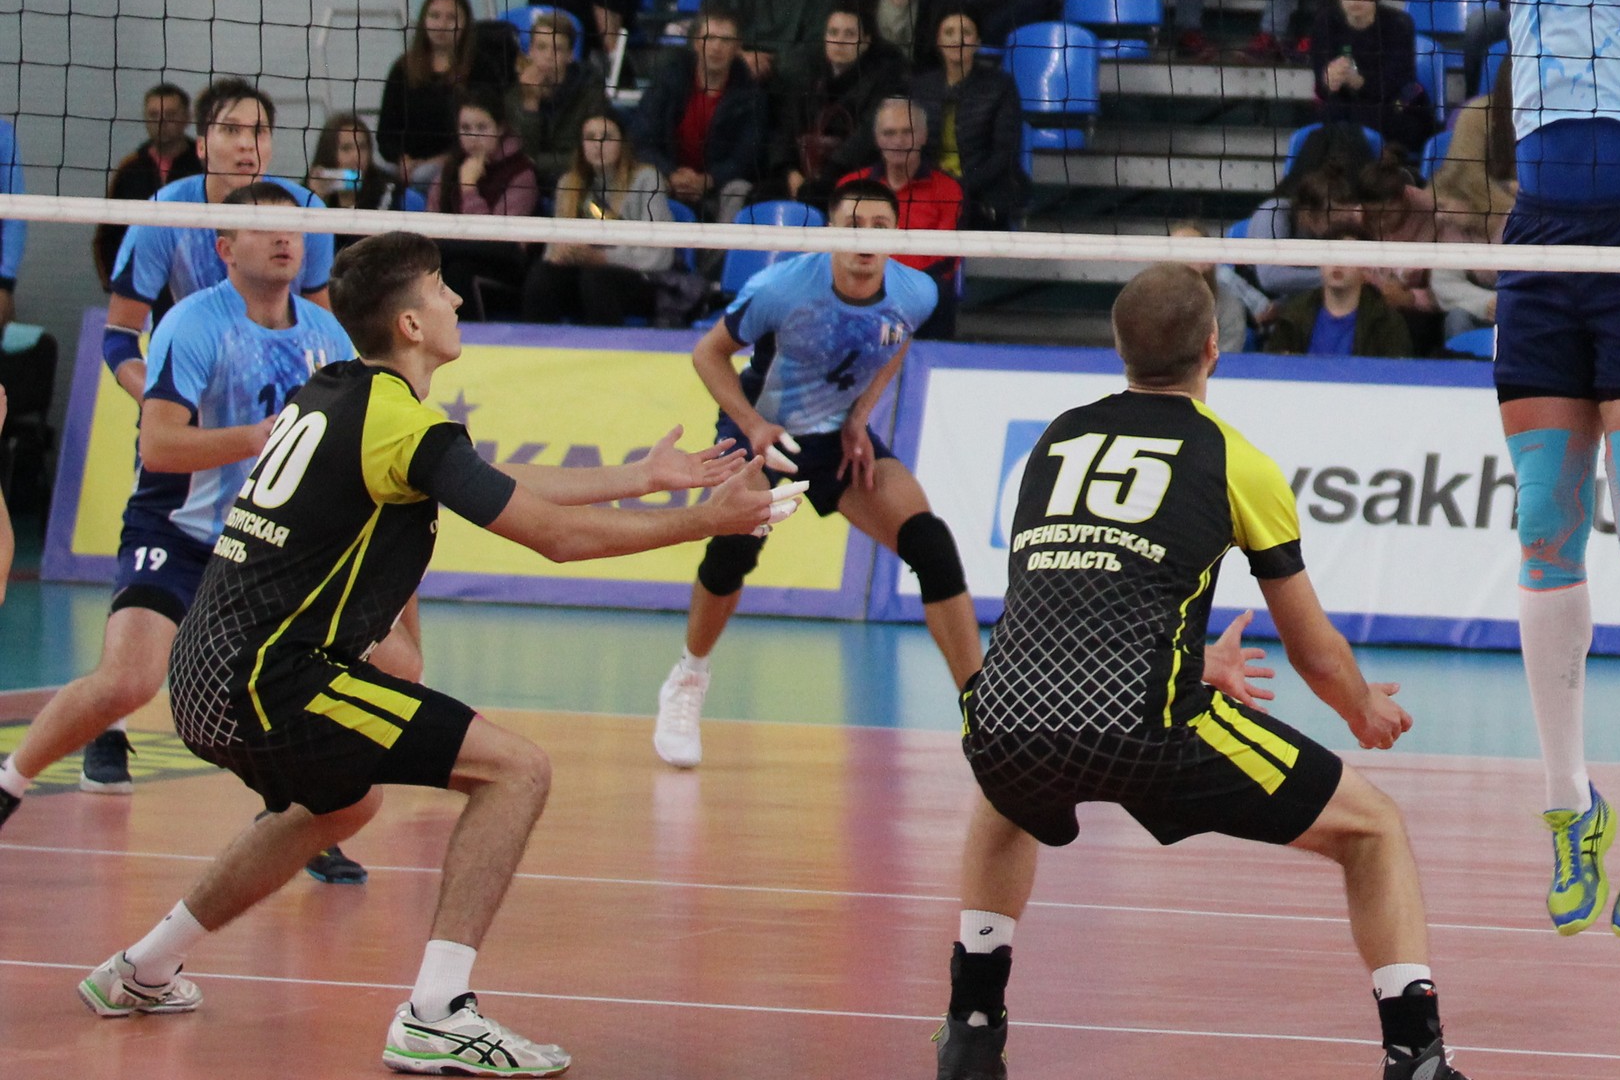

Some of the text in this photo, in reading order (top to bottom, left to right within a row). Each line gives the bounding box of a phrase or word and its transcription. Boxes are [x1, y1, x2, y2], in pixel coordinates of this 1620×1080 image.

[826, 350, 860, 391] 4
[237, 402, 328, 509] 20
[1044, 432, 1184, 523] 15
[135, 546, 168, 572] 19
[1012, 523, 1166, 564] ОРЕНБУРГСКАЯ
[1027, 551, 1122, 572] ОБЛАСТЬ
